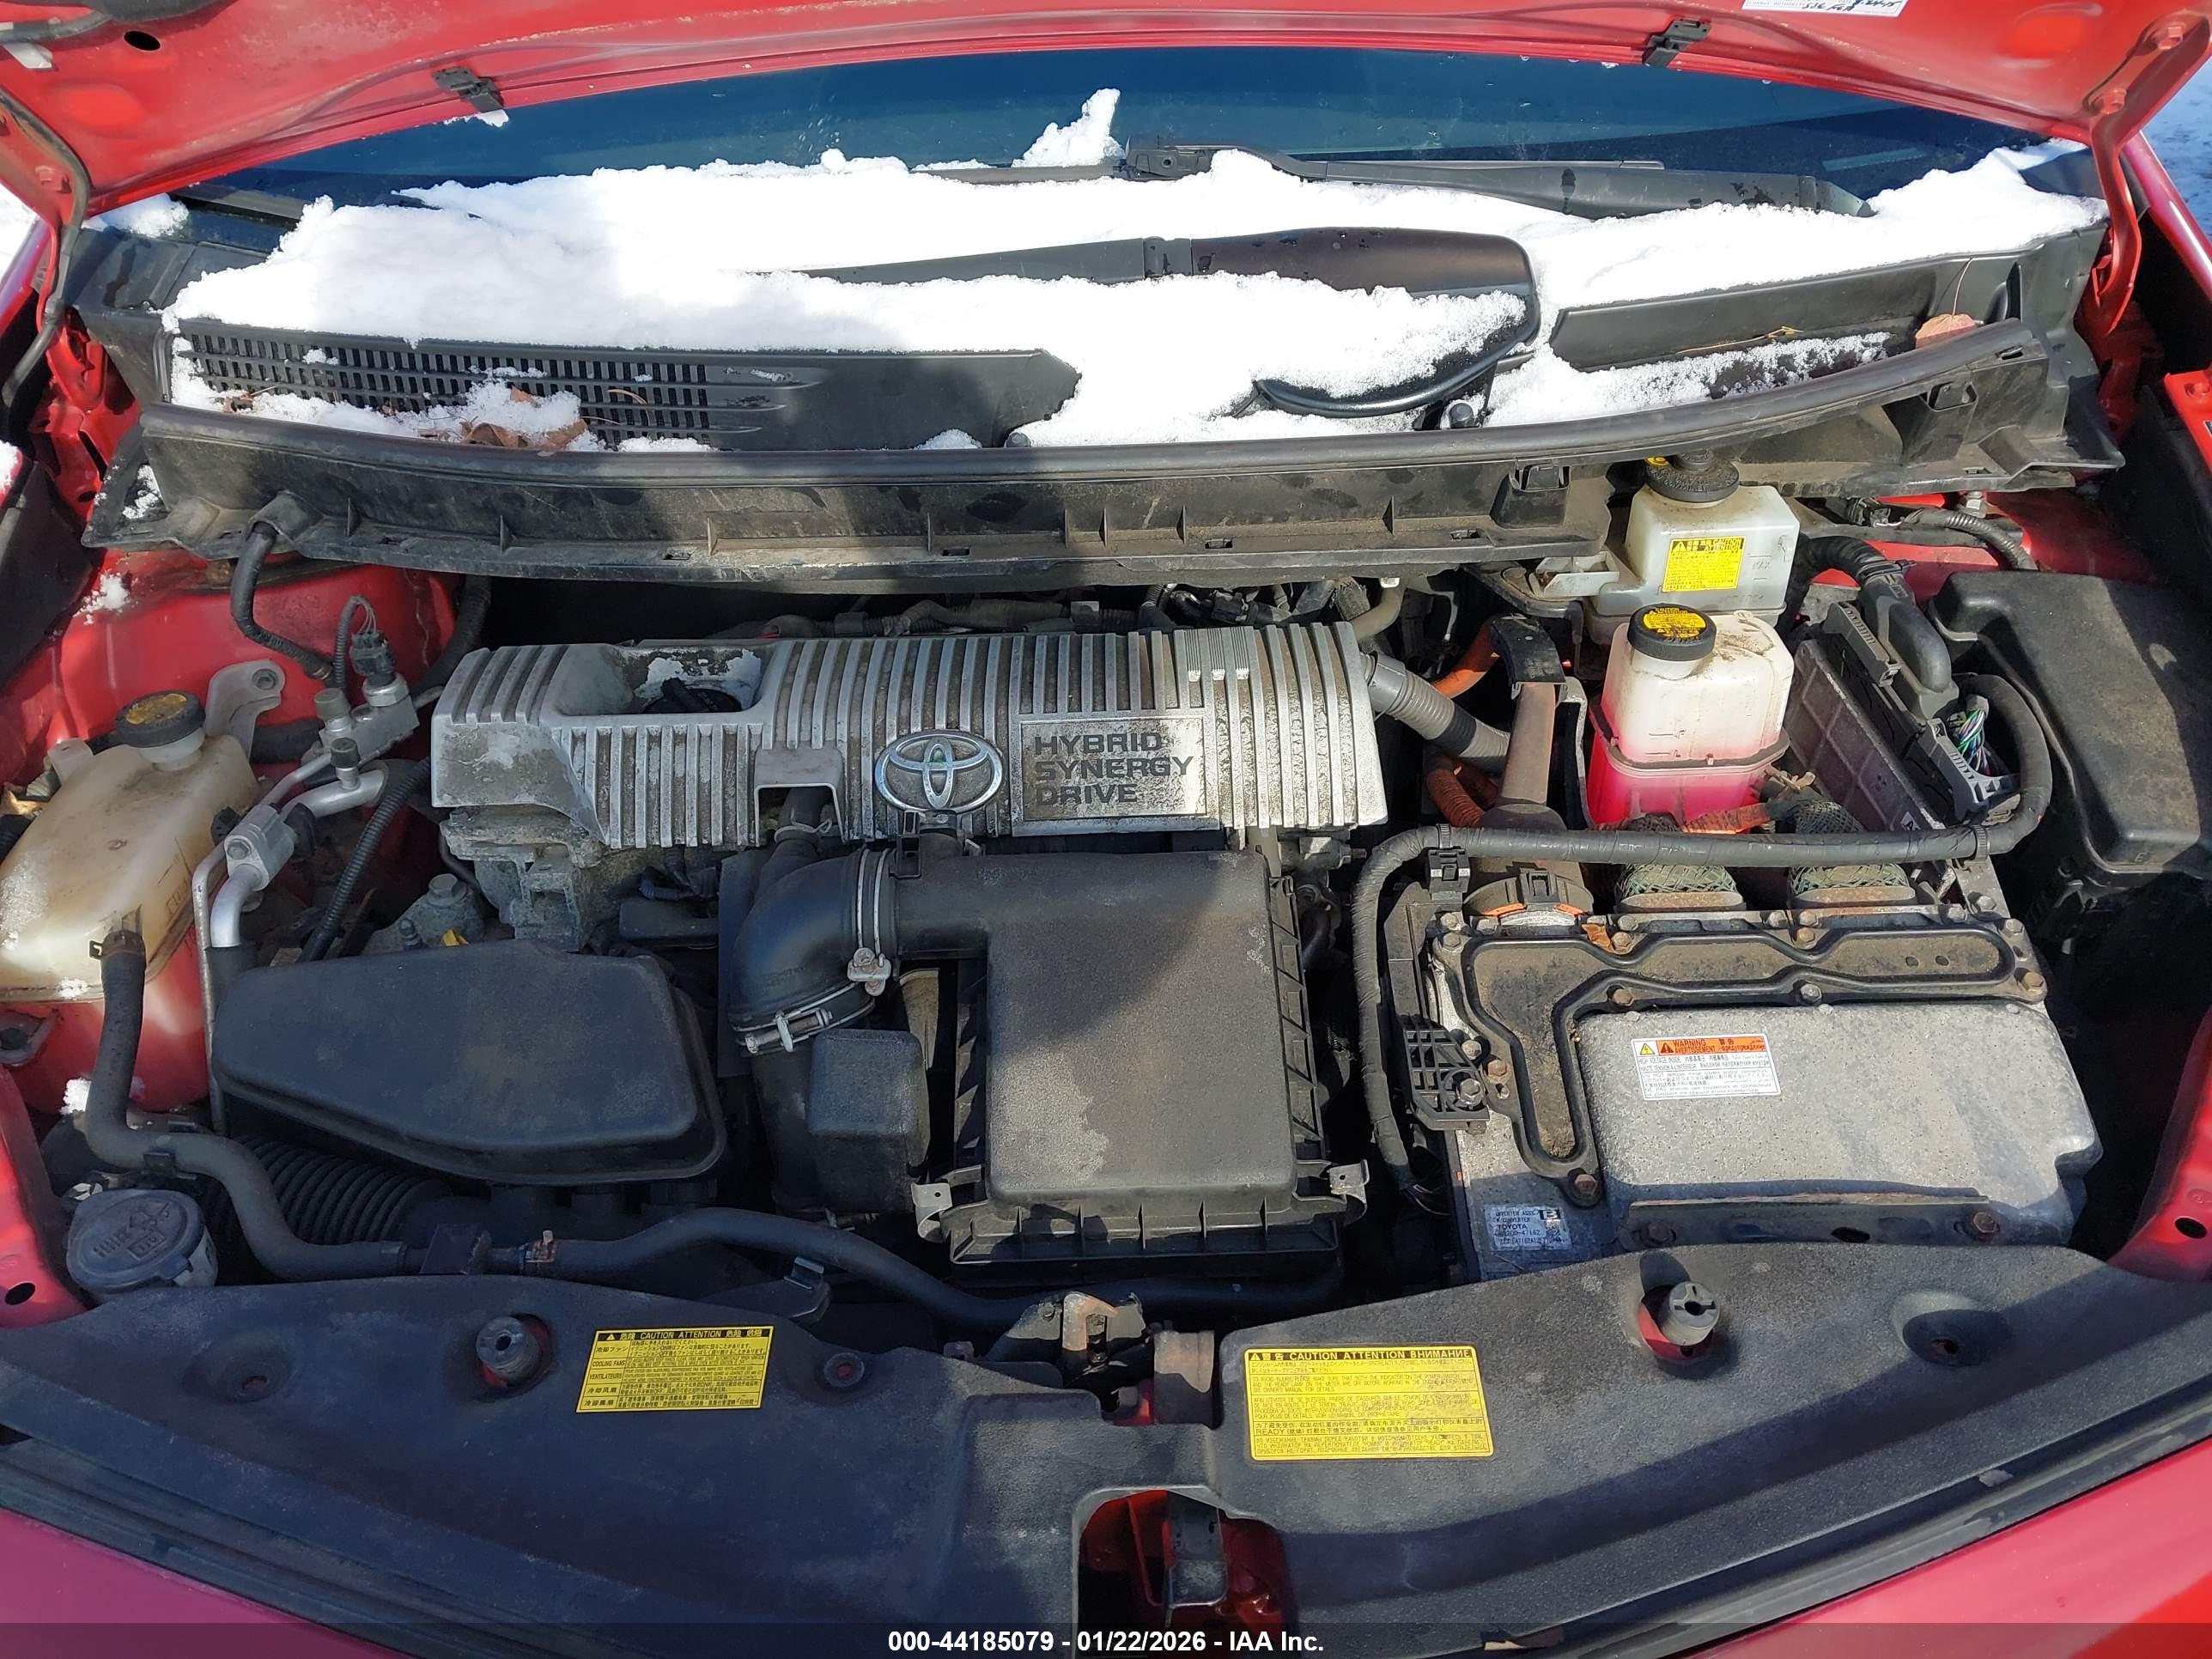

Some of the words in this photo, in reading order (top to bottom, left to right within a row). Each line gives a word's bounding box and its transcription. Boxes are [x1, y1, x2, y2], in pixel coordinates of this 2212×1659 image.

[1034, 732, 1162, 755] HYBRID
[1035, 756, 1194, 781] SYNERGY
[1036, 783, 1138, 805] DRIVE
[1543, 1211, 1559, 1219] B
[1343, 1351, 1406, 1360] ATTENTION
[1410, 1350, 1471, 1358] ВНИМАНИЕ
